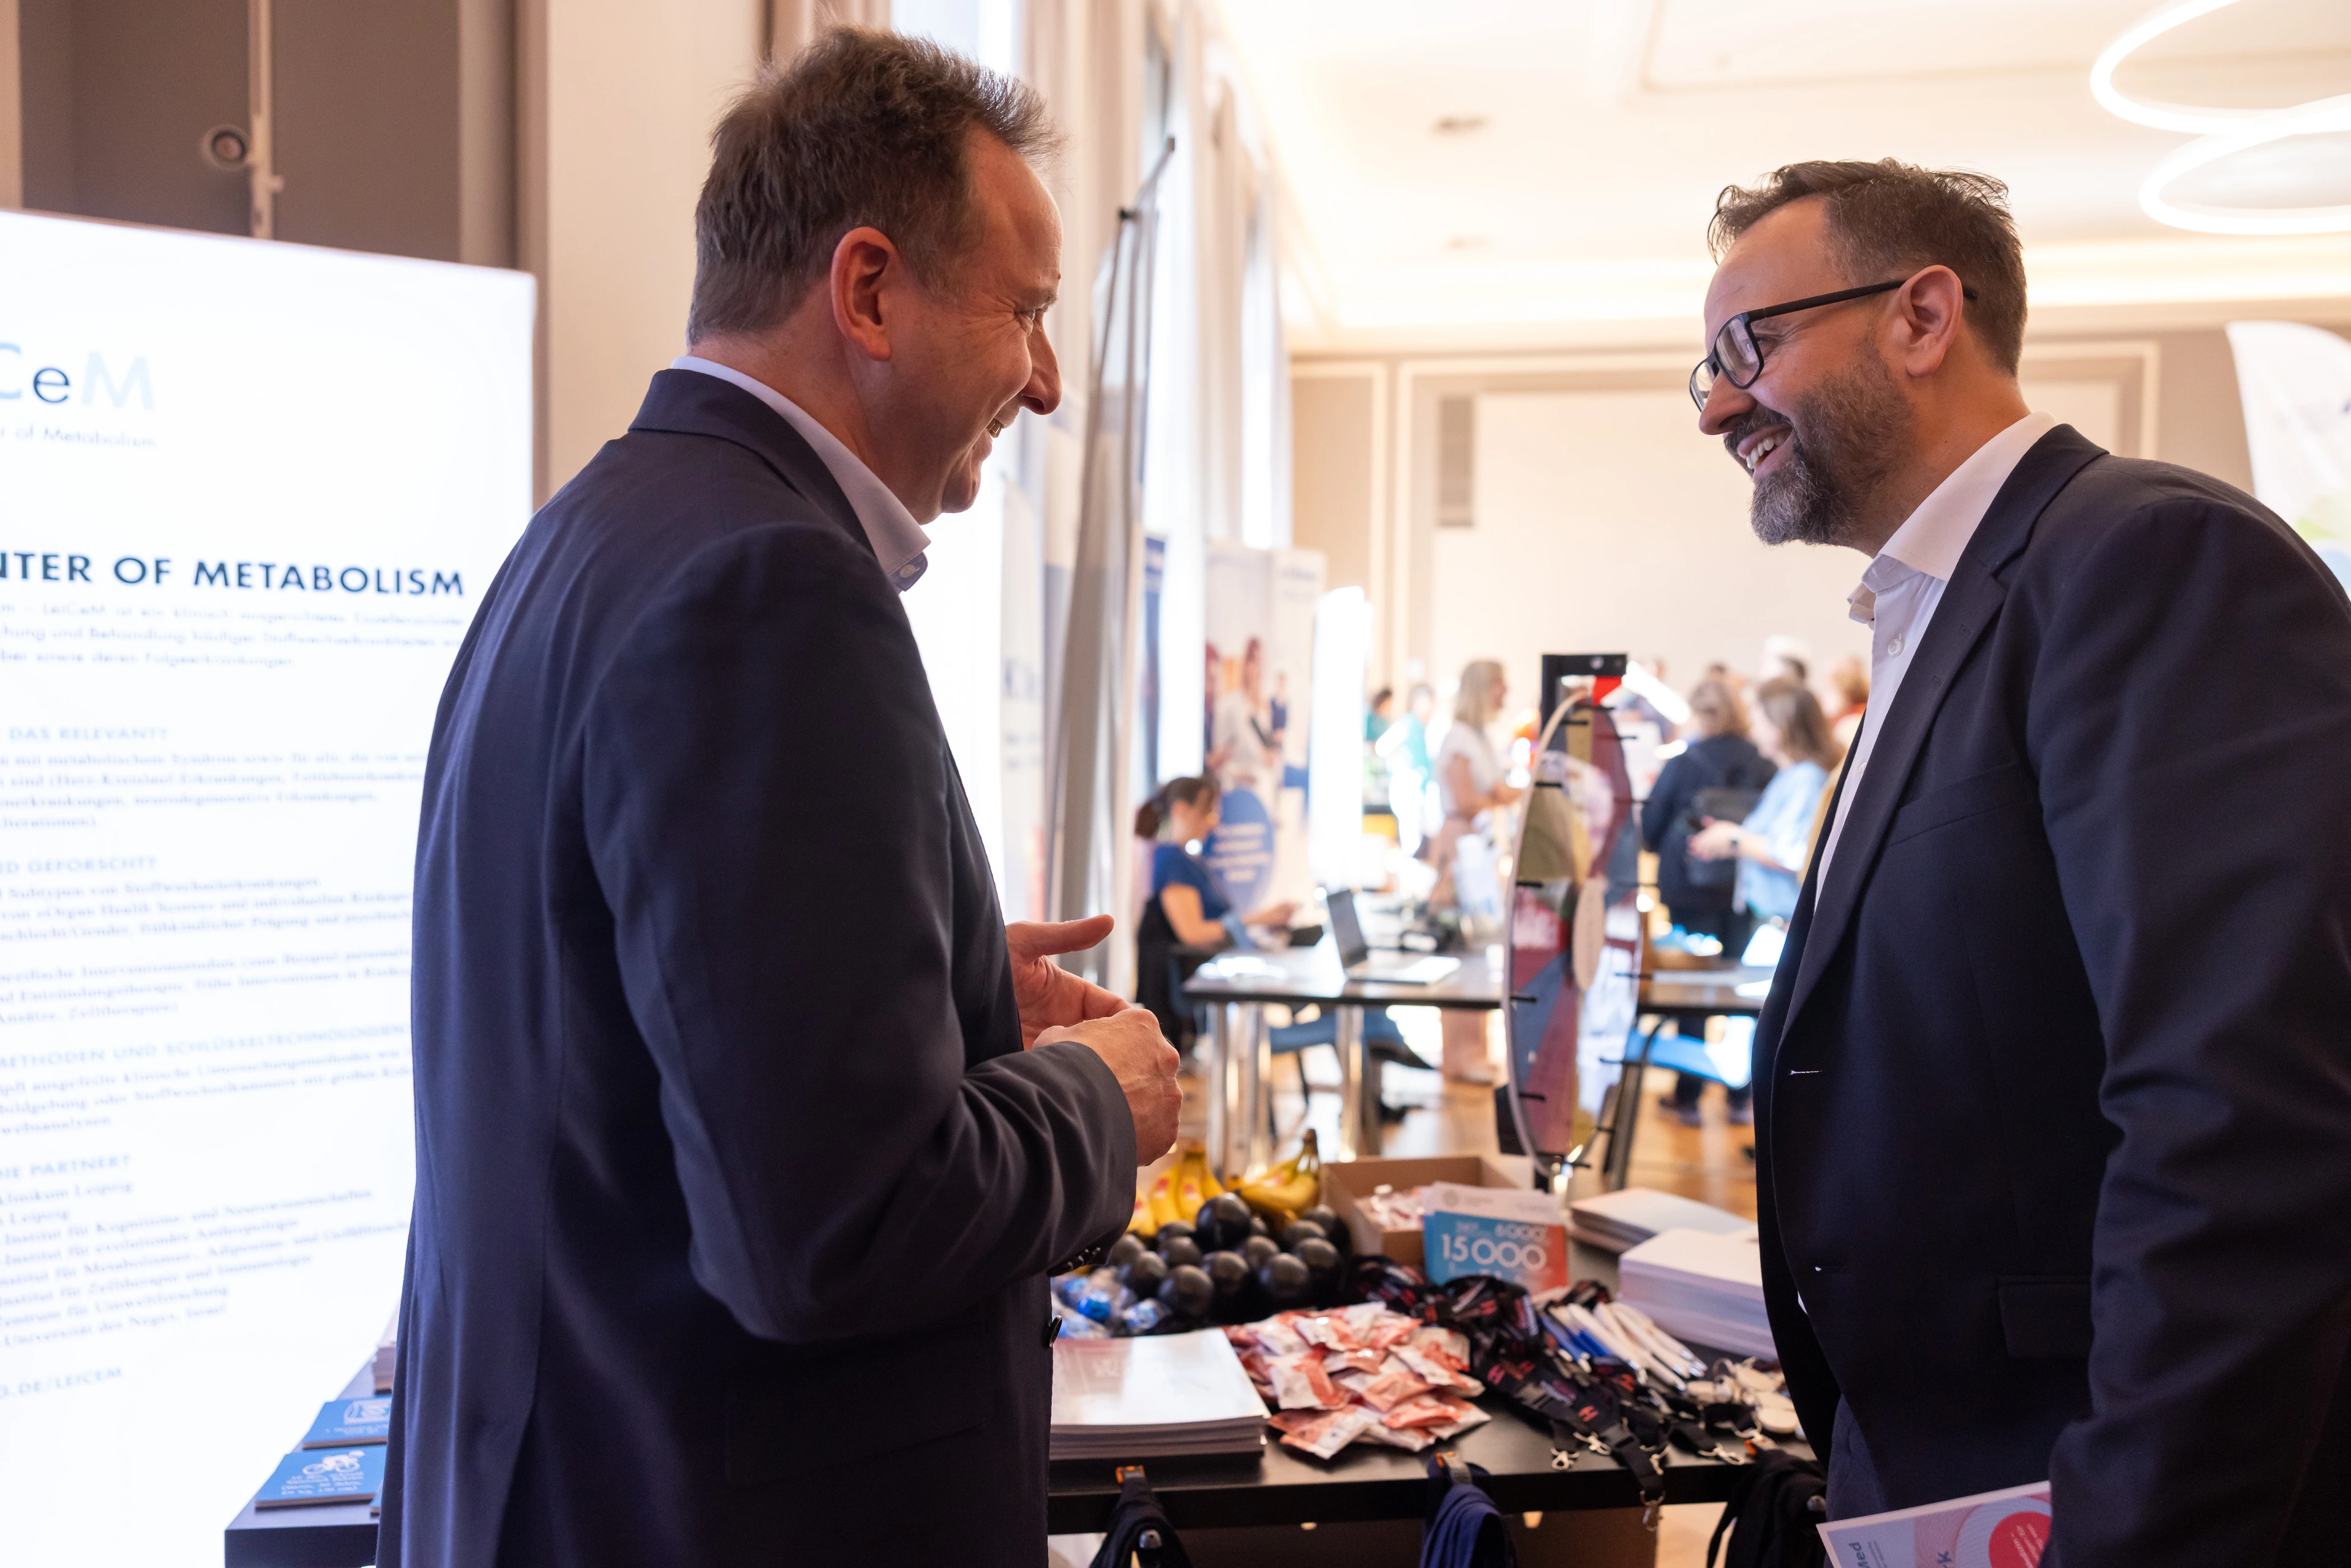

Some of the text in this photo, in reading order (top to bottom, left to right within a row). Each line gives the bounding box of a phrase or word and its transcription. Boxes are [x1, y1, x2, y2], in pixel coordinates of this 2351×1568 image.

[15, 424, 34, 440] of
[43, 427, 157, 448] Metabolism
[0, 552, 463, 596] TER OF METABOLISM
[9, 726, 168, 741] DAS RELEVANT?
[30, 1153, 131, 1178] PARTNER?
